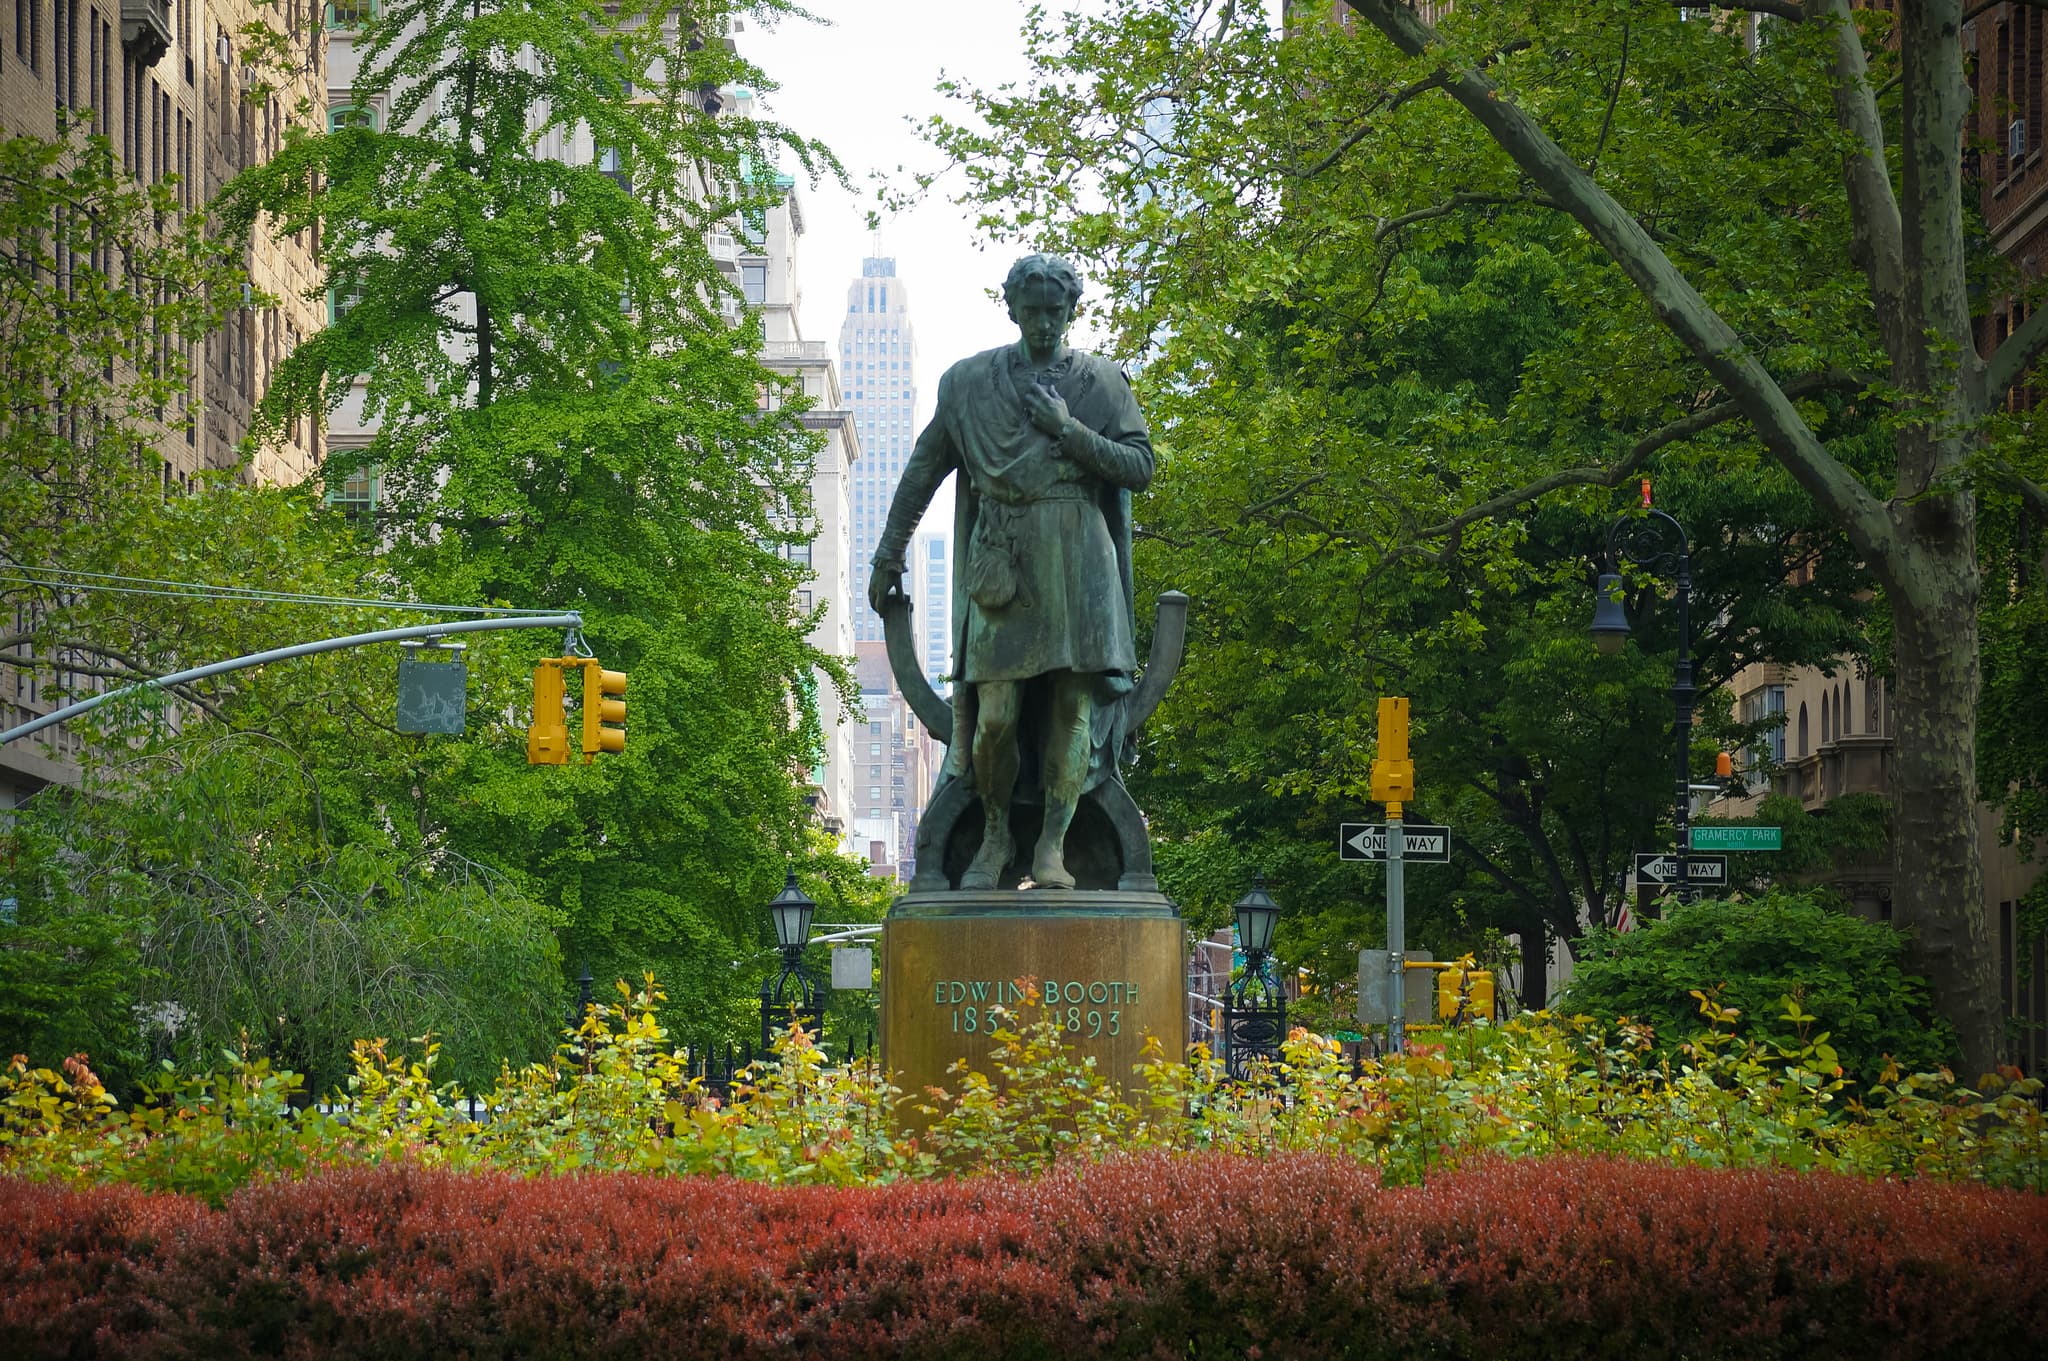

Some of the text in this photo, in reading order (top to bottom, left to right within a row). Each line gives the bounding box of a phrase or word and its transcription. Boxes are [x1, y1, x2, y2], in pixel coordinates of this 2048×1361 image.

[1694, 829, 1777, 841] GRAMERCY PARK
[1406, 836, 1437, 851] WAY
[1653, 863, 1716, 876] ONE WAY
[934, 980, 1140, 1005] EDWIN BOOTH
[1055, 1006, 1121, 1039] 1893
